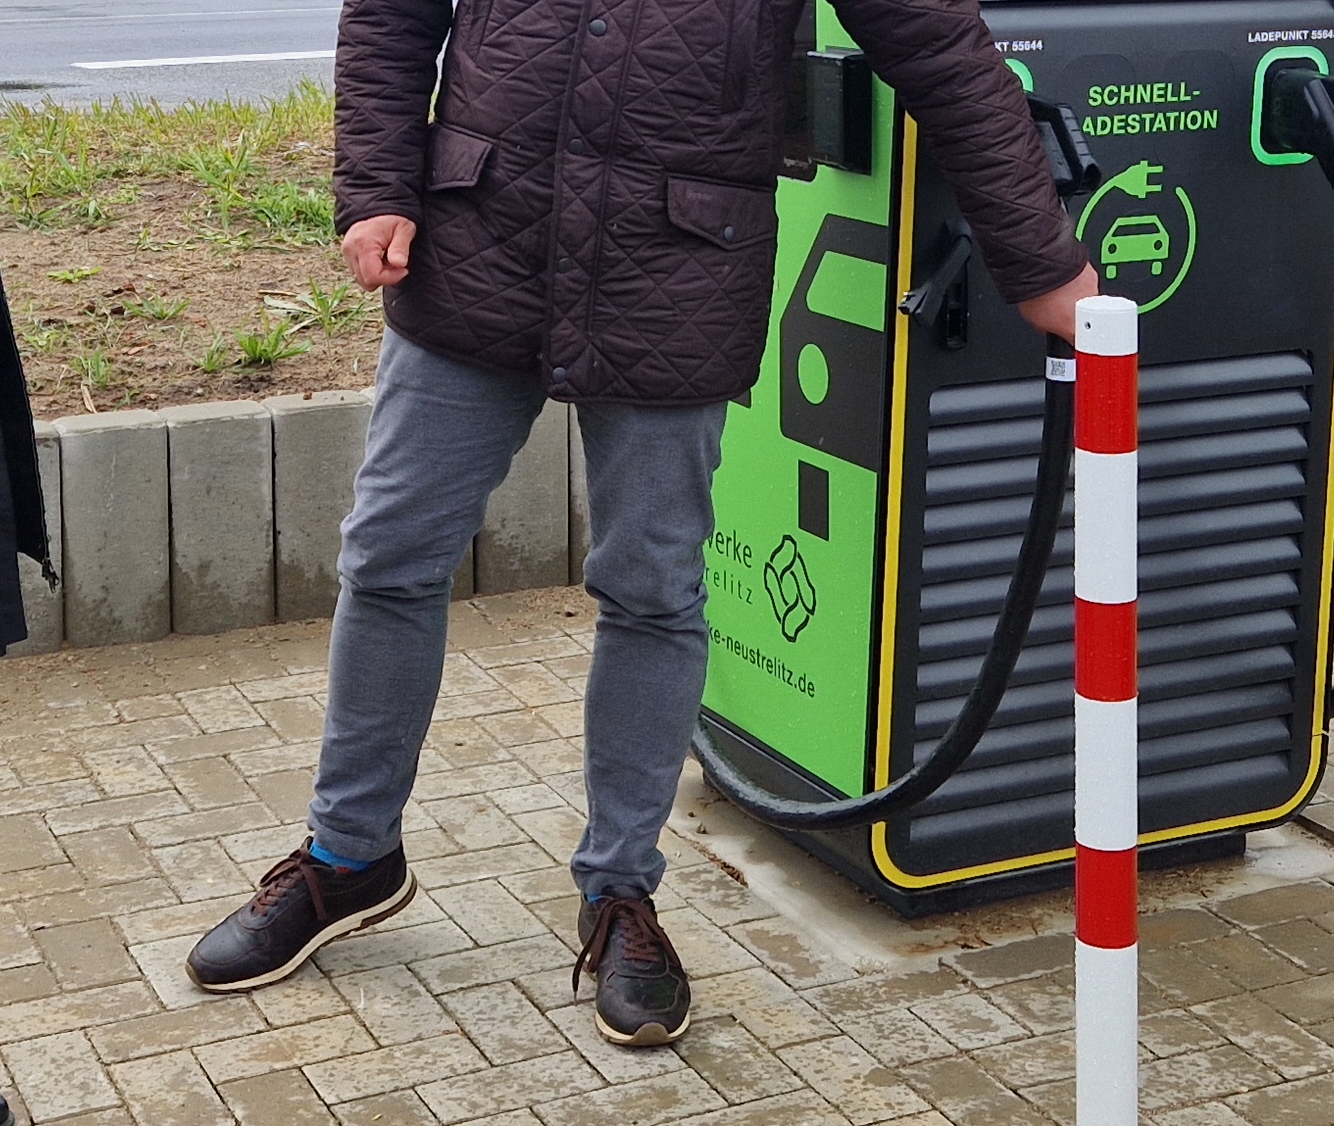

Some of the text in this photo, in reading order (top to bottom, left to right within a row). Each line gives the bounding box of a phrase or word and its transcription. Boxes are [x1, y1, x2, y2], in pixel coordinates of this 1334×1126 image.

[993, 41, 1010, 53] KT
[1248, 30, 1309, 43] LADEPUNKT
[1087, 81, 1201, 107] SCHNELL-
[1082, 109, 1218, 136] ADESTATION
[705, 567, 752, 605] relitz
[707, 620, 816, 698] ke-neustrelitz.de
